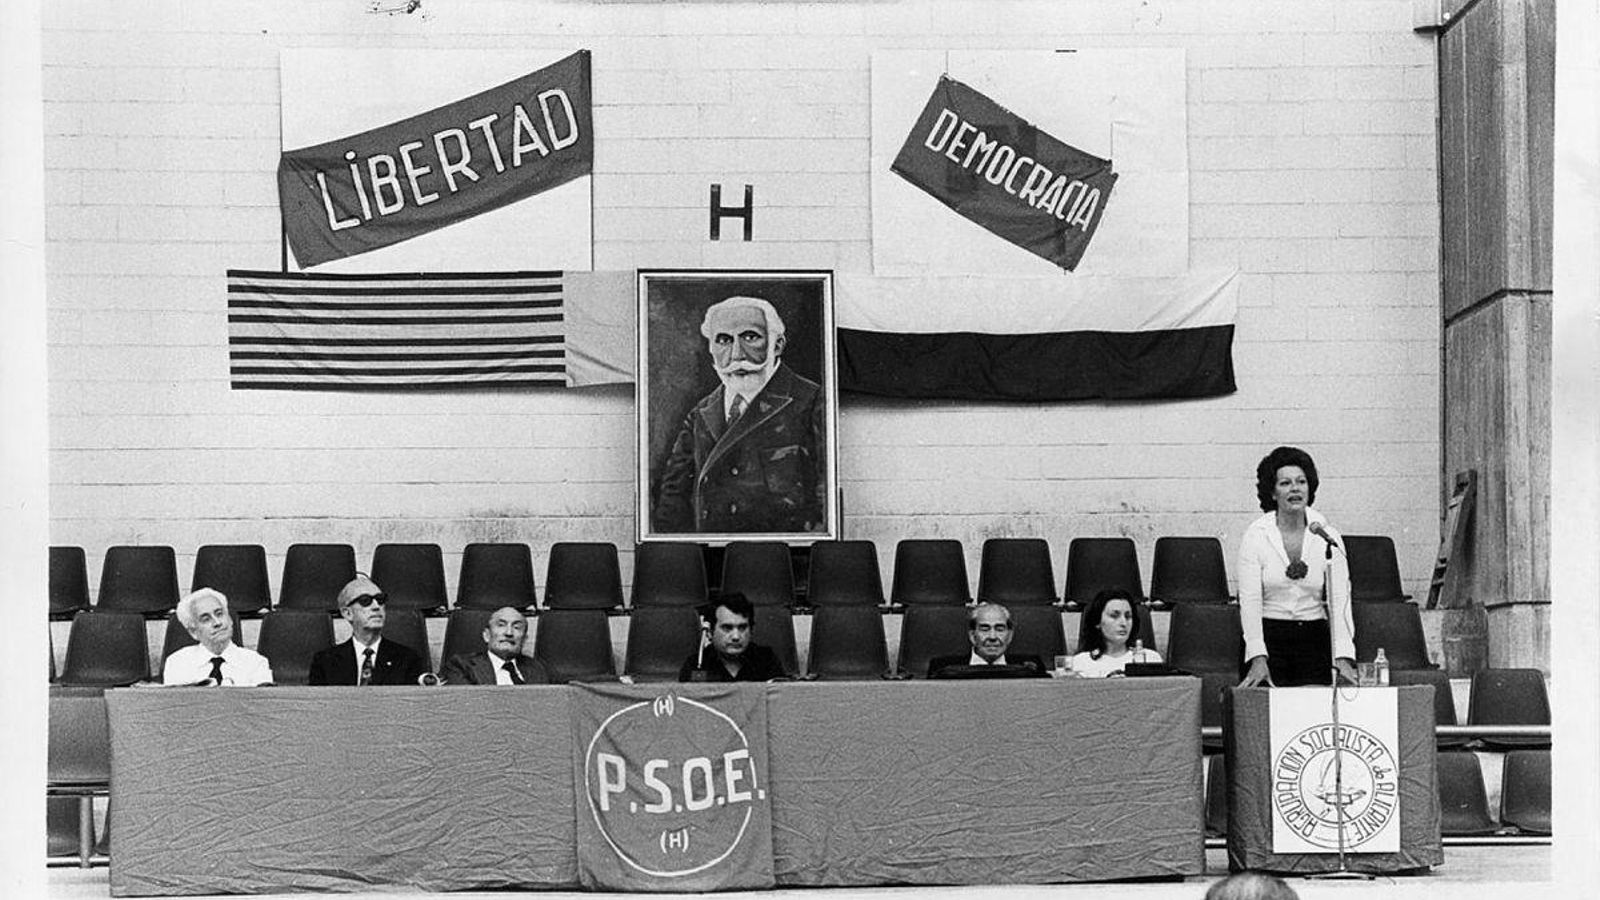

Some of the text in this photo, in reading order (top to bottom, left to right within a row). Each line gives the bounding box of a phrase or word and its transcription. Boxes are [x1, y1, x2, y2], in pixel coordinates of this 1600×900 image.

[710, 184, 753, 241] H
[924, 107, 1101, 232] DEMOCRACIA
[597, 749, 765, 814] P.S.O.E.
[1275, 746, 1318, 838] AGRUPACION
[1300, 727, 1384, 763] SOCIALISTA
[1351, 782, 1395, 842] ALICANTE
